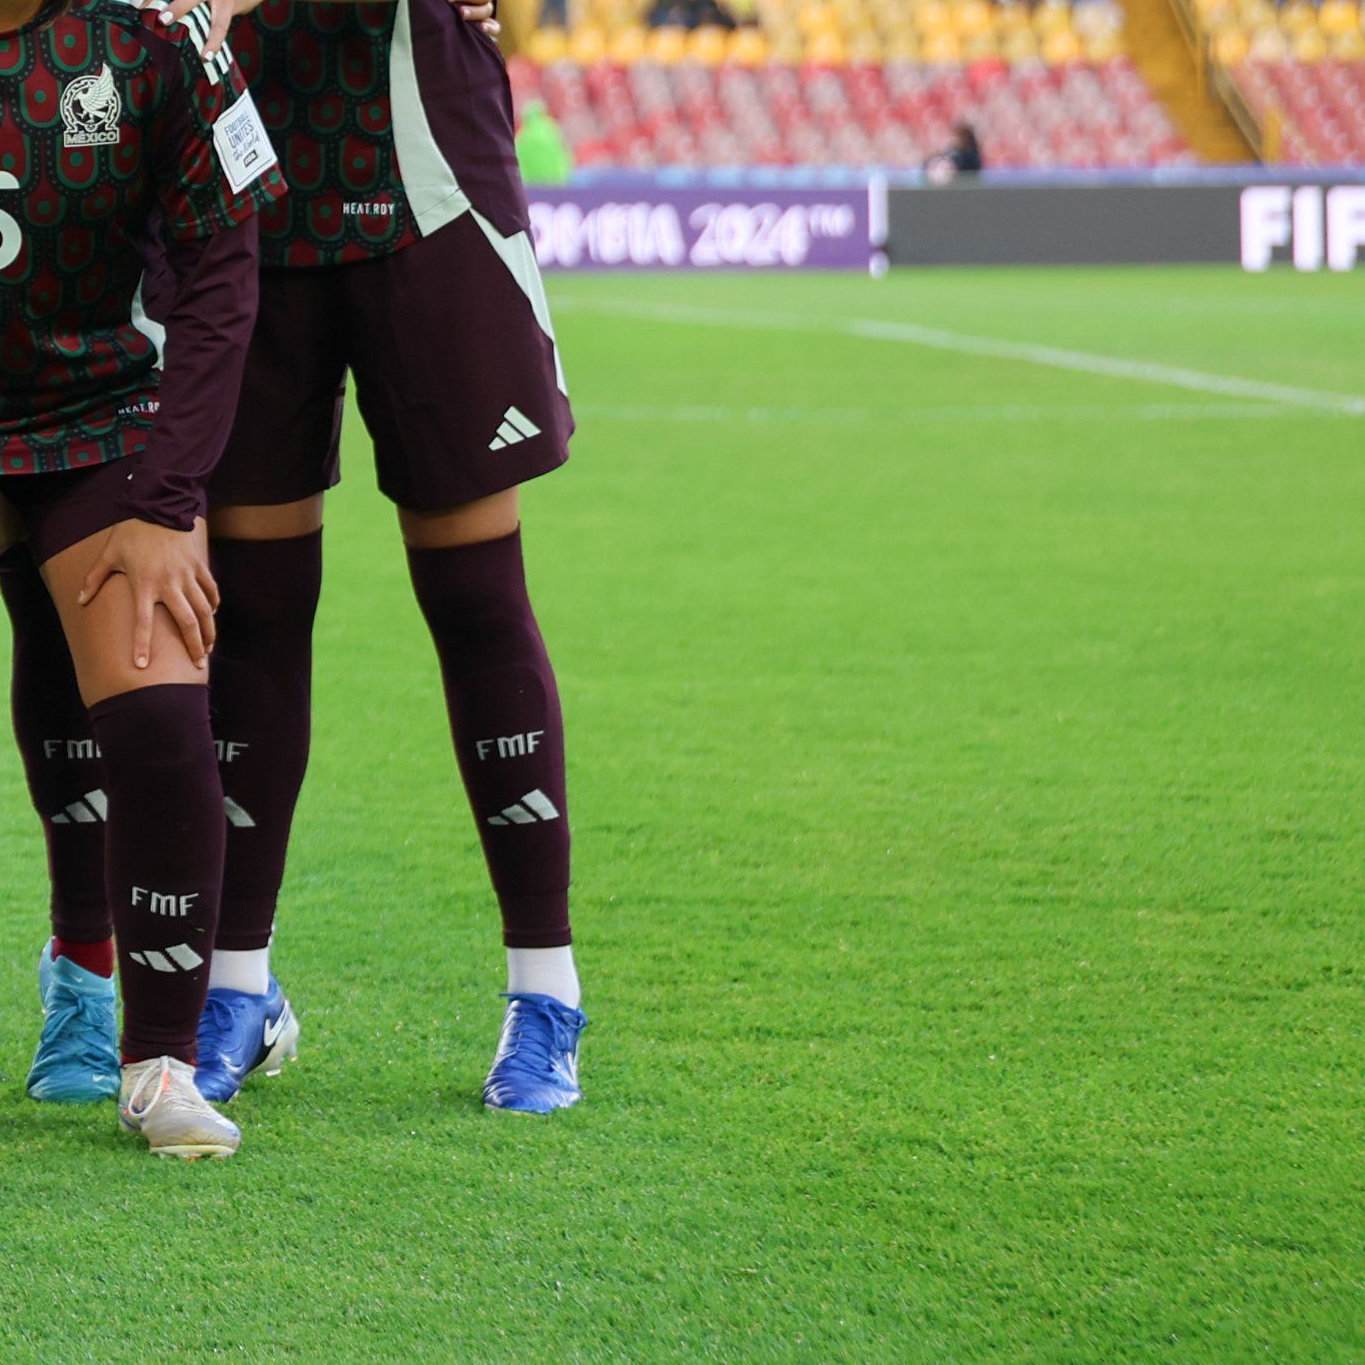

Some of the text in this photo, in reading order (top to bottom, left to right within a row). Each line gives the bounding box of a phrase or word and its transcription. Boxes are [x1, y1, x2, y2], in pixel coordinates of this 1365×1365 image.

[66, 131, 117, 145] MÉXICO
[1240, 185, 1365, 273] FIF
[43, 739, 102, 760] FM
[475, 730, 545, 762] FMF
[130, 885, 200, 919] FMF
